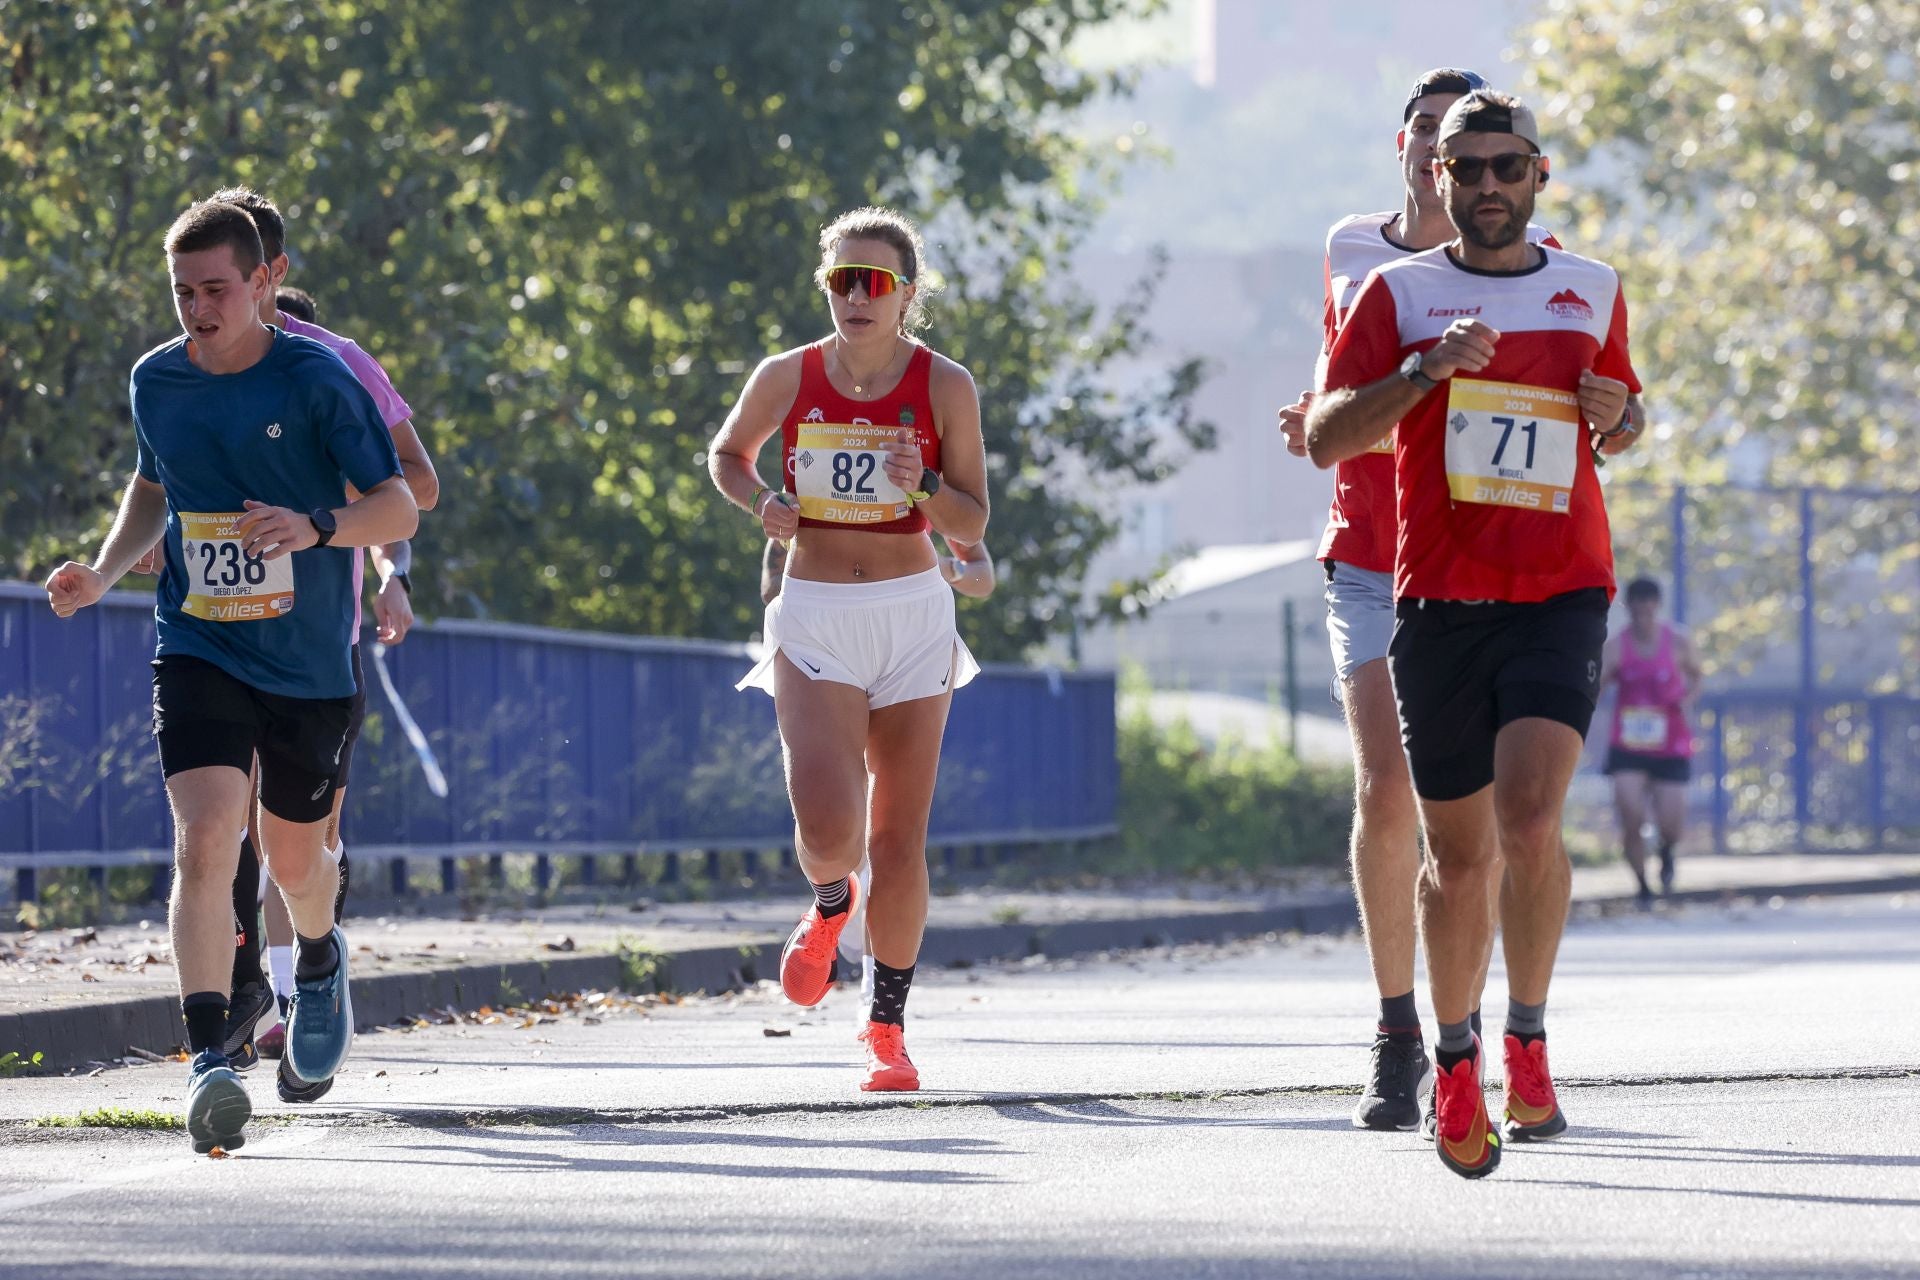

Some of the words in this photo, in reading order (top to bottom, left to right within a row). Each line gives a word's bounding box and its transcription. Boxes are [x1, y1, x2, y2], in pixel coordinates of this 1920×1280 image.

[1427, 306, 1482, 317] land
[1511, 388, 1553, 400] MARATÓN
[1504, 400, 1533, 412] 2024
[823, 427, 846, 436] MEDIA
[847, 427, 886, 436] MARATÓN
[843, 438, 867, 447] 2024
[1491, 416, 1537, 469] 71
[832, 452, 876, 494] 82
[1498, 468, 1524, 479] MIGUEL
[831, 491, 854, 502] MARINA
[854, 493, 878, 503] GUERRA
[1474, 486, 1542, 507] avilés
[824, 507, 884, 521] avilés
[200, 542, 266, 586] 238
[213, 587, 231, 596] DIEGO
[232, 586, 253, 595] LÓPEZ
[209, 602, 265, 618] avilés
